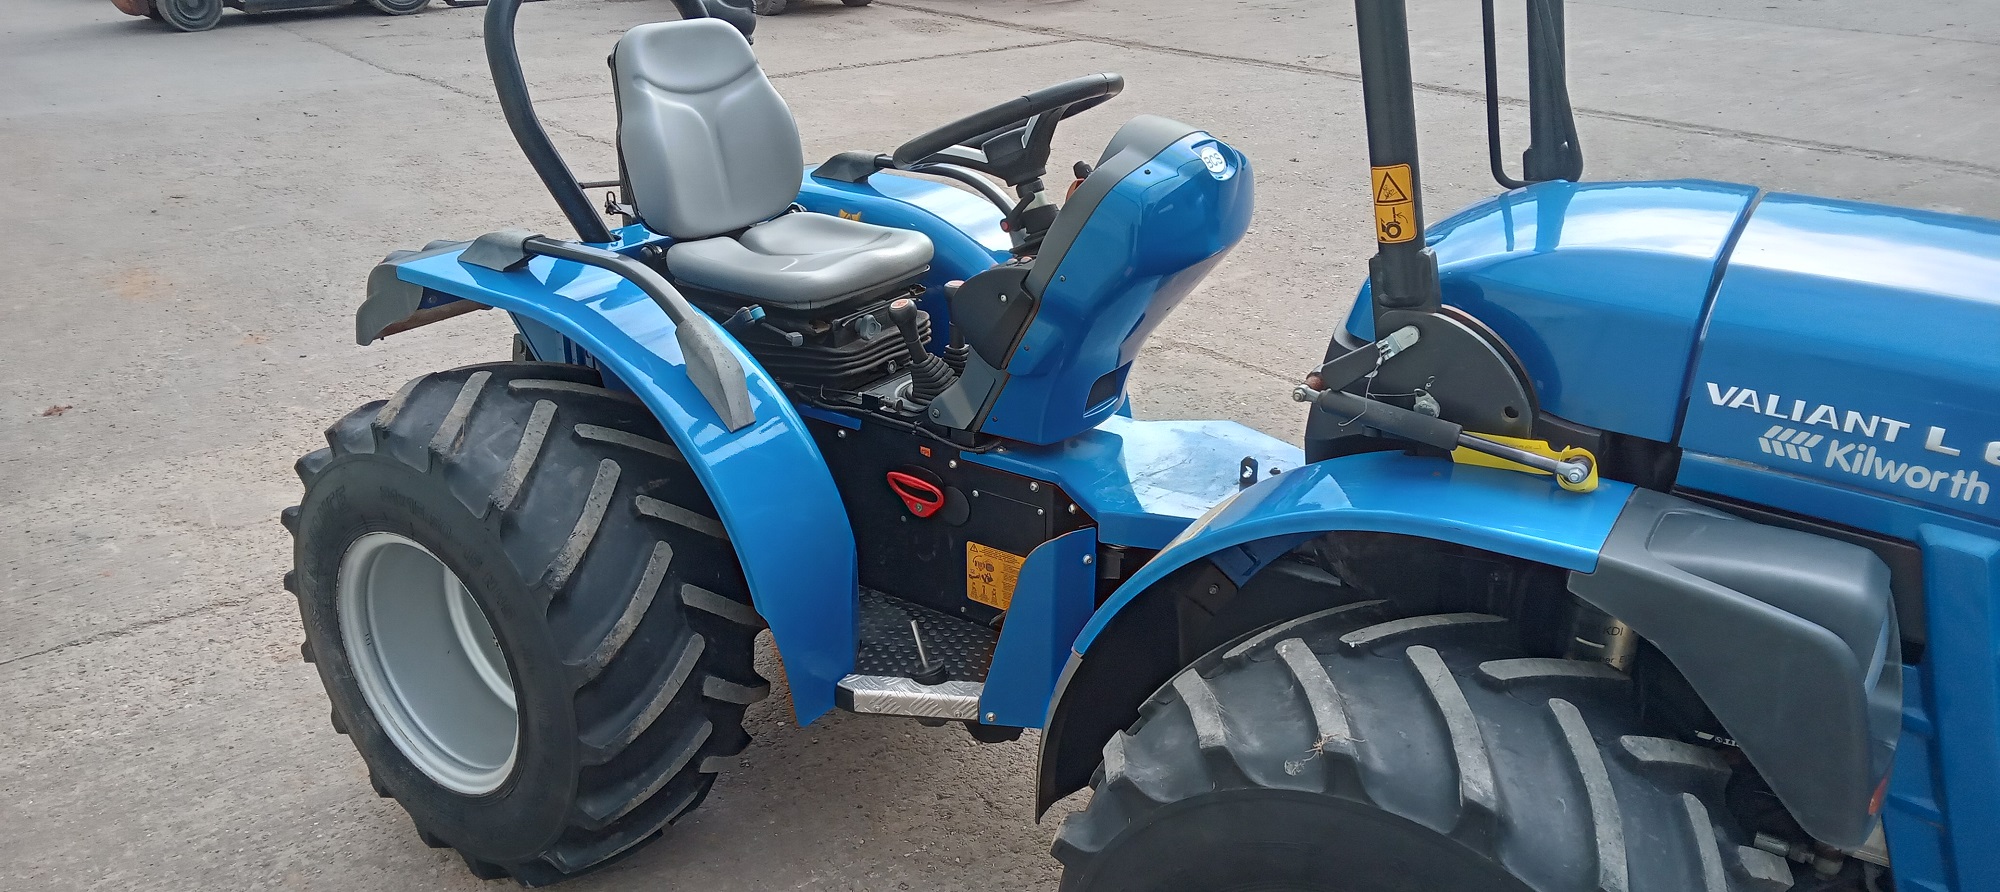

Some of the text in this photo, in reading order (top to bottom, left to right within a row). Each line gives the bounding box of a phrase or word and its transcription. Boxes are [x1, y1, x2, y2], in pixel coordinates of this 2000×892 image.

[1203, 152, 1223, 169] BCS
[1707, 382, 1911, 443] VALIANT
[1925, 426, 1961, 456] L
[1825, 439, 1990, 505] Kilworth
